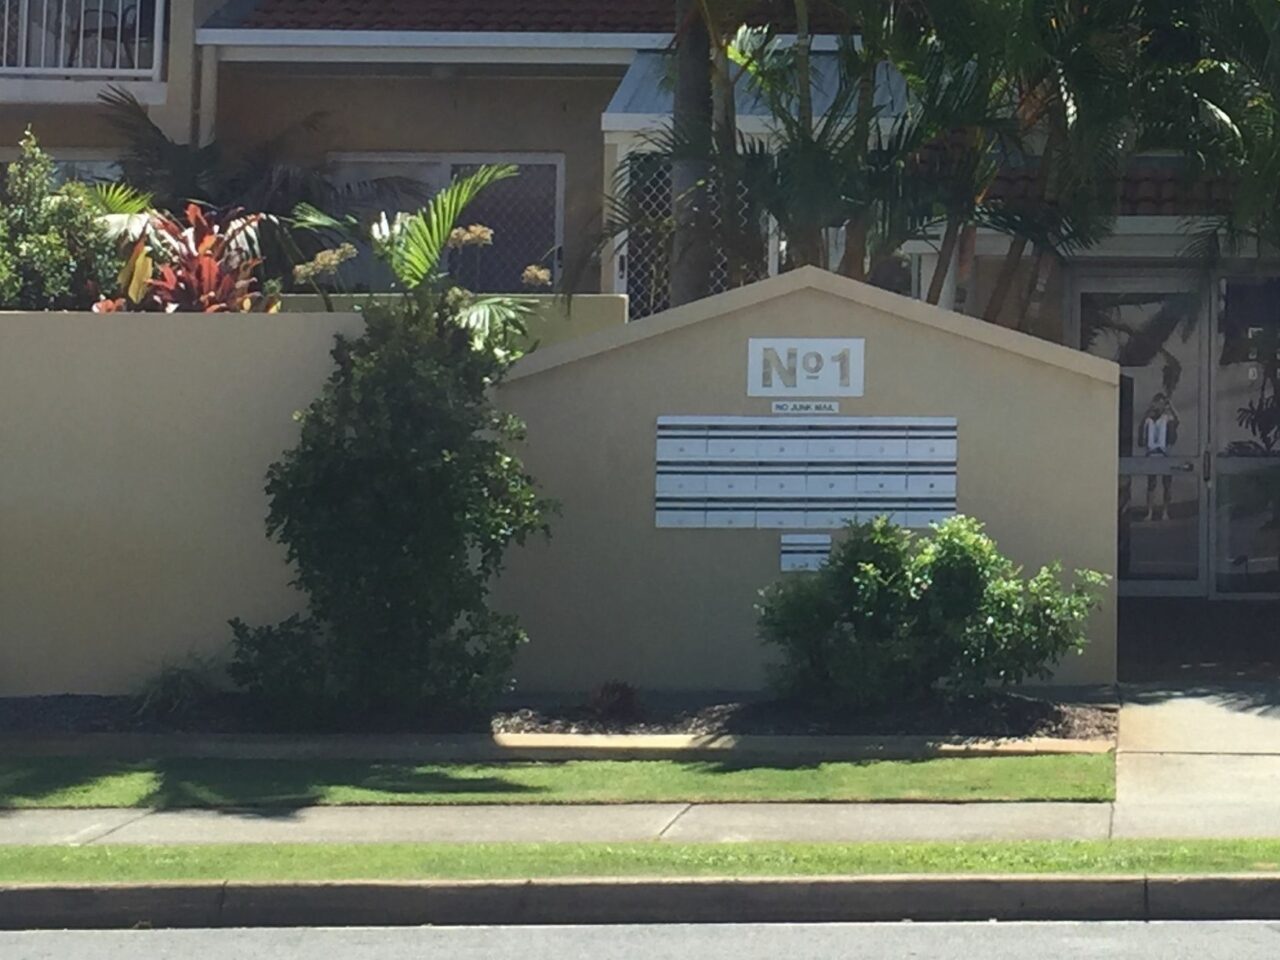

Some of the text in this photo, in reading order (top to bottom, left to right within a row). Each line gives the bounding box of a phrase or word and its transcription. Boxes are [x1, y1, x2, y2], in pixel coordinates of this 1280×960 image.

[775, 403, 834, 411] NO JUNK MAIL
